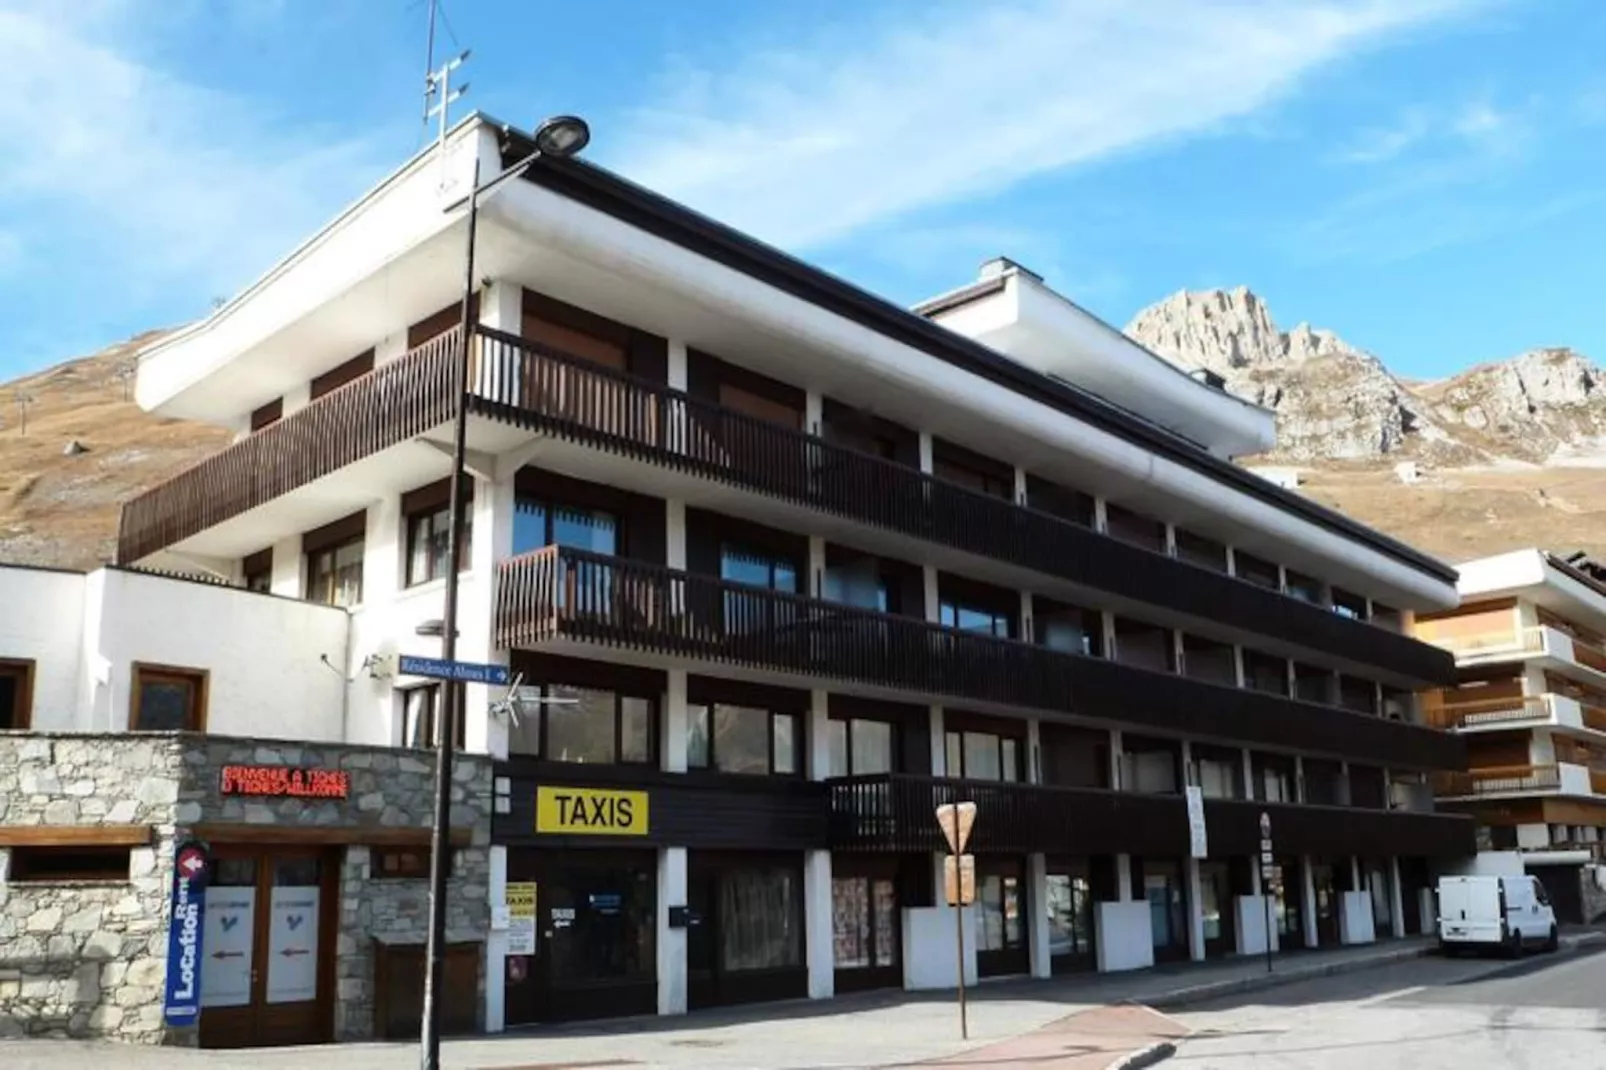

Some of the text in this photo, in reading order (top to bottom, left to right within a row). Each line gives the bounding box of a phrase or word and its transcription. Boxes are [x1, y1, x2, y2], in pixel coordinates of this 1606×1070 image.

[402, 658, 451, 677] Résidence
[555, 795, 633, 827] TAXIS
[174, 877, 190, 920] Rent
